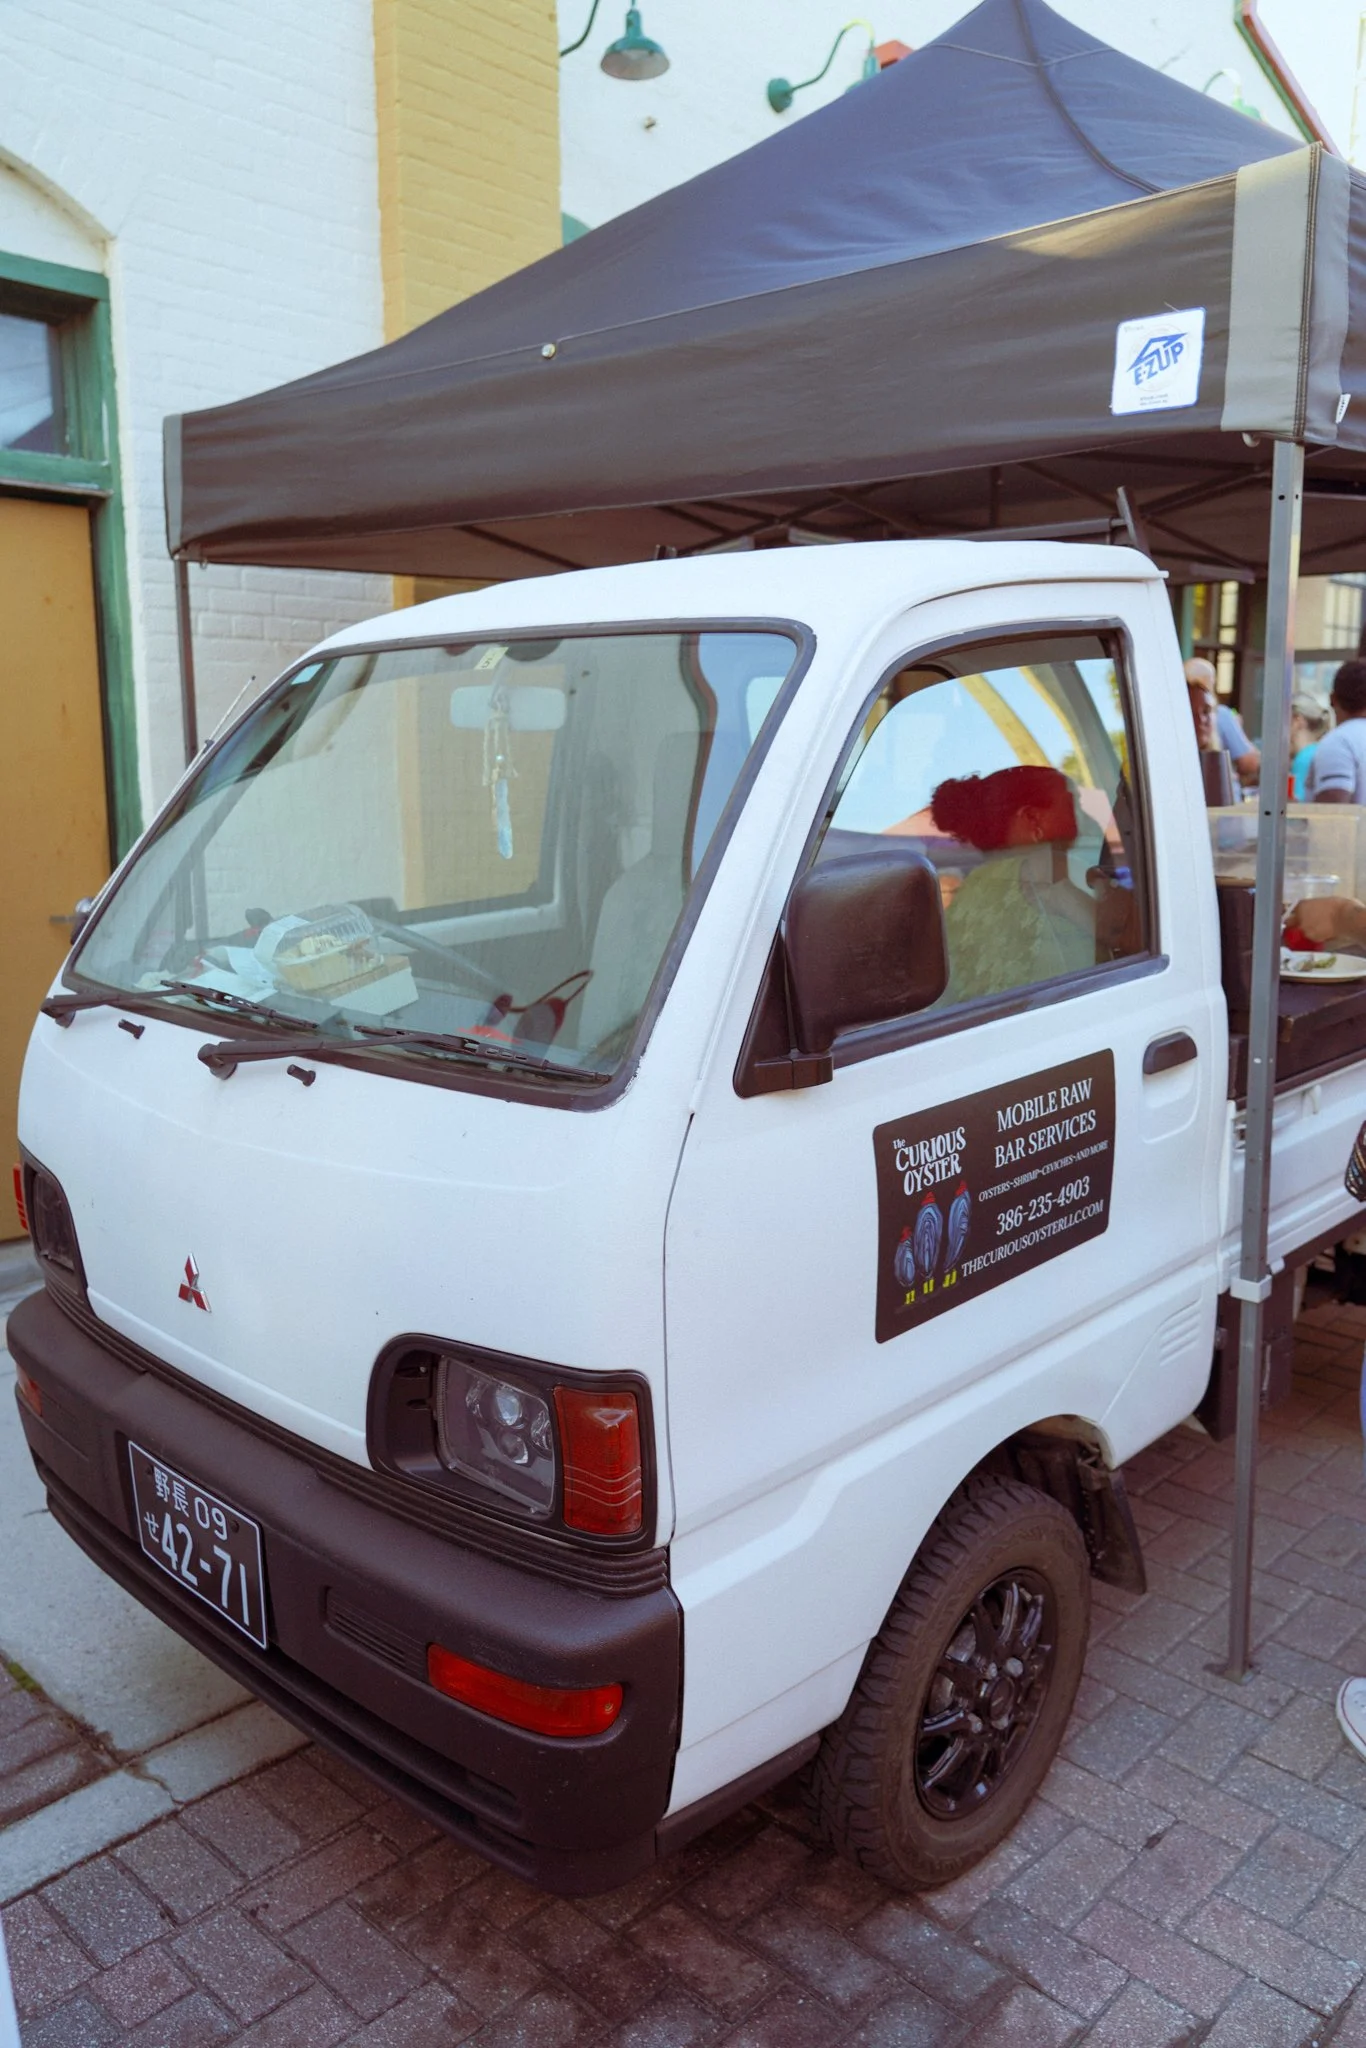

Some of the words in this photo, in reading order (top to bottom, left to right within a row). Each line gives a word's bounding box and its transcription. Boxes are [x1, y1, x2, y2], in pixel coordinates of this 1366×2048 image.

[996, 1091, 1059, 1133] MOBILE
[1060, 1078, 1093, 1110] RAW
[892, 1138, 906, 1150] The
[895, 1126, 967, 1172] CURIOUS
[994, 1137, 1026, 1169] BAR
[1027, 1109, 1097, 1155] SERVICES
[903, 1152, 963, 1196] OYSTER
[996, 1175, 1090, 1236] 386-235-4903
[961, 1199, 1104, 1278] THECURIOUSOYSTERLLC.COM
[194, 1496, 228, 1541] 09
[161, 1512, 250, 1627] 42-71
